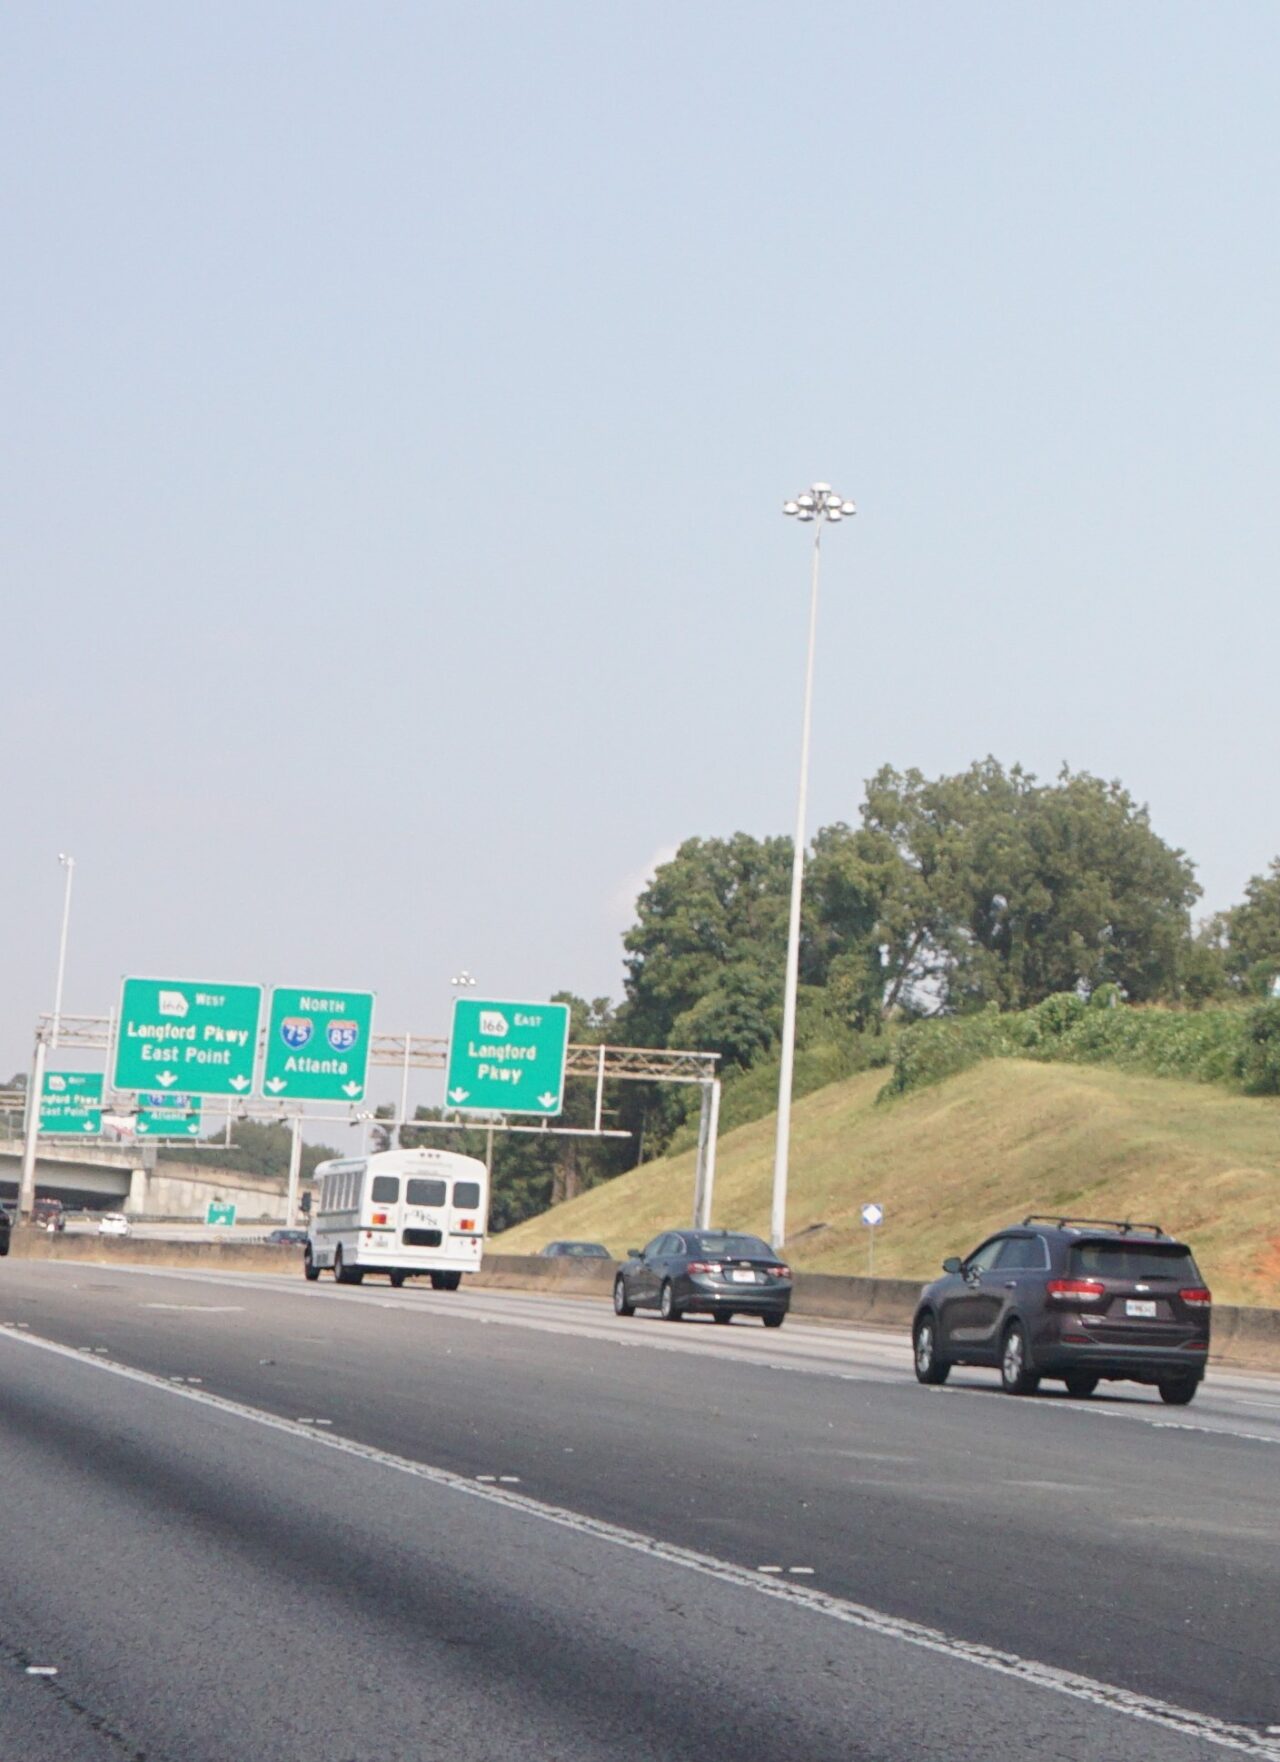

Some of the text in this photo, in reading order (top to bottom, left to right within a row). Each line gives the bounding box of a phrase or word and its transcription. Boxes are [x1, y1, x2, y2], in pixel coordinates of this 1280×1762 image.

[300, 996, 345, 1013] NORTH
[482, 1012, 542, 1032] 166 EAST
[127, 1021, 249, 1047] Langford Pkwy
[286, 1025, 354, 1046] 75 85
[141, 1044, 231, 1065] East Point
[468, 1041, 537, 1063] Langford
[284, 1056, 349, 1075] Atlanta
[477, 1063, 523, 1085] Pkwy
